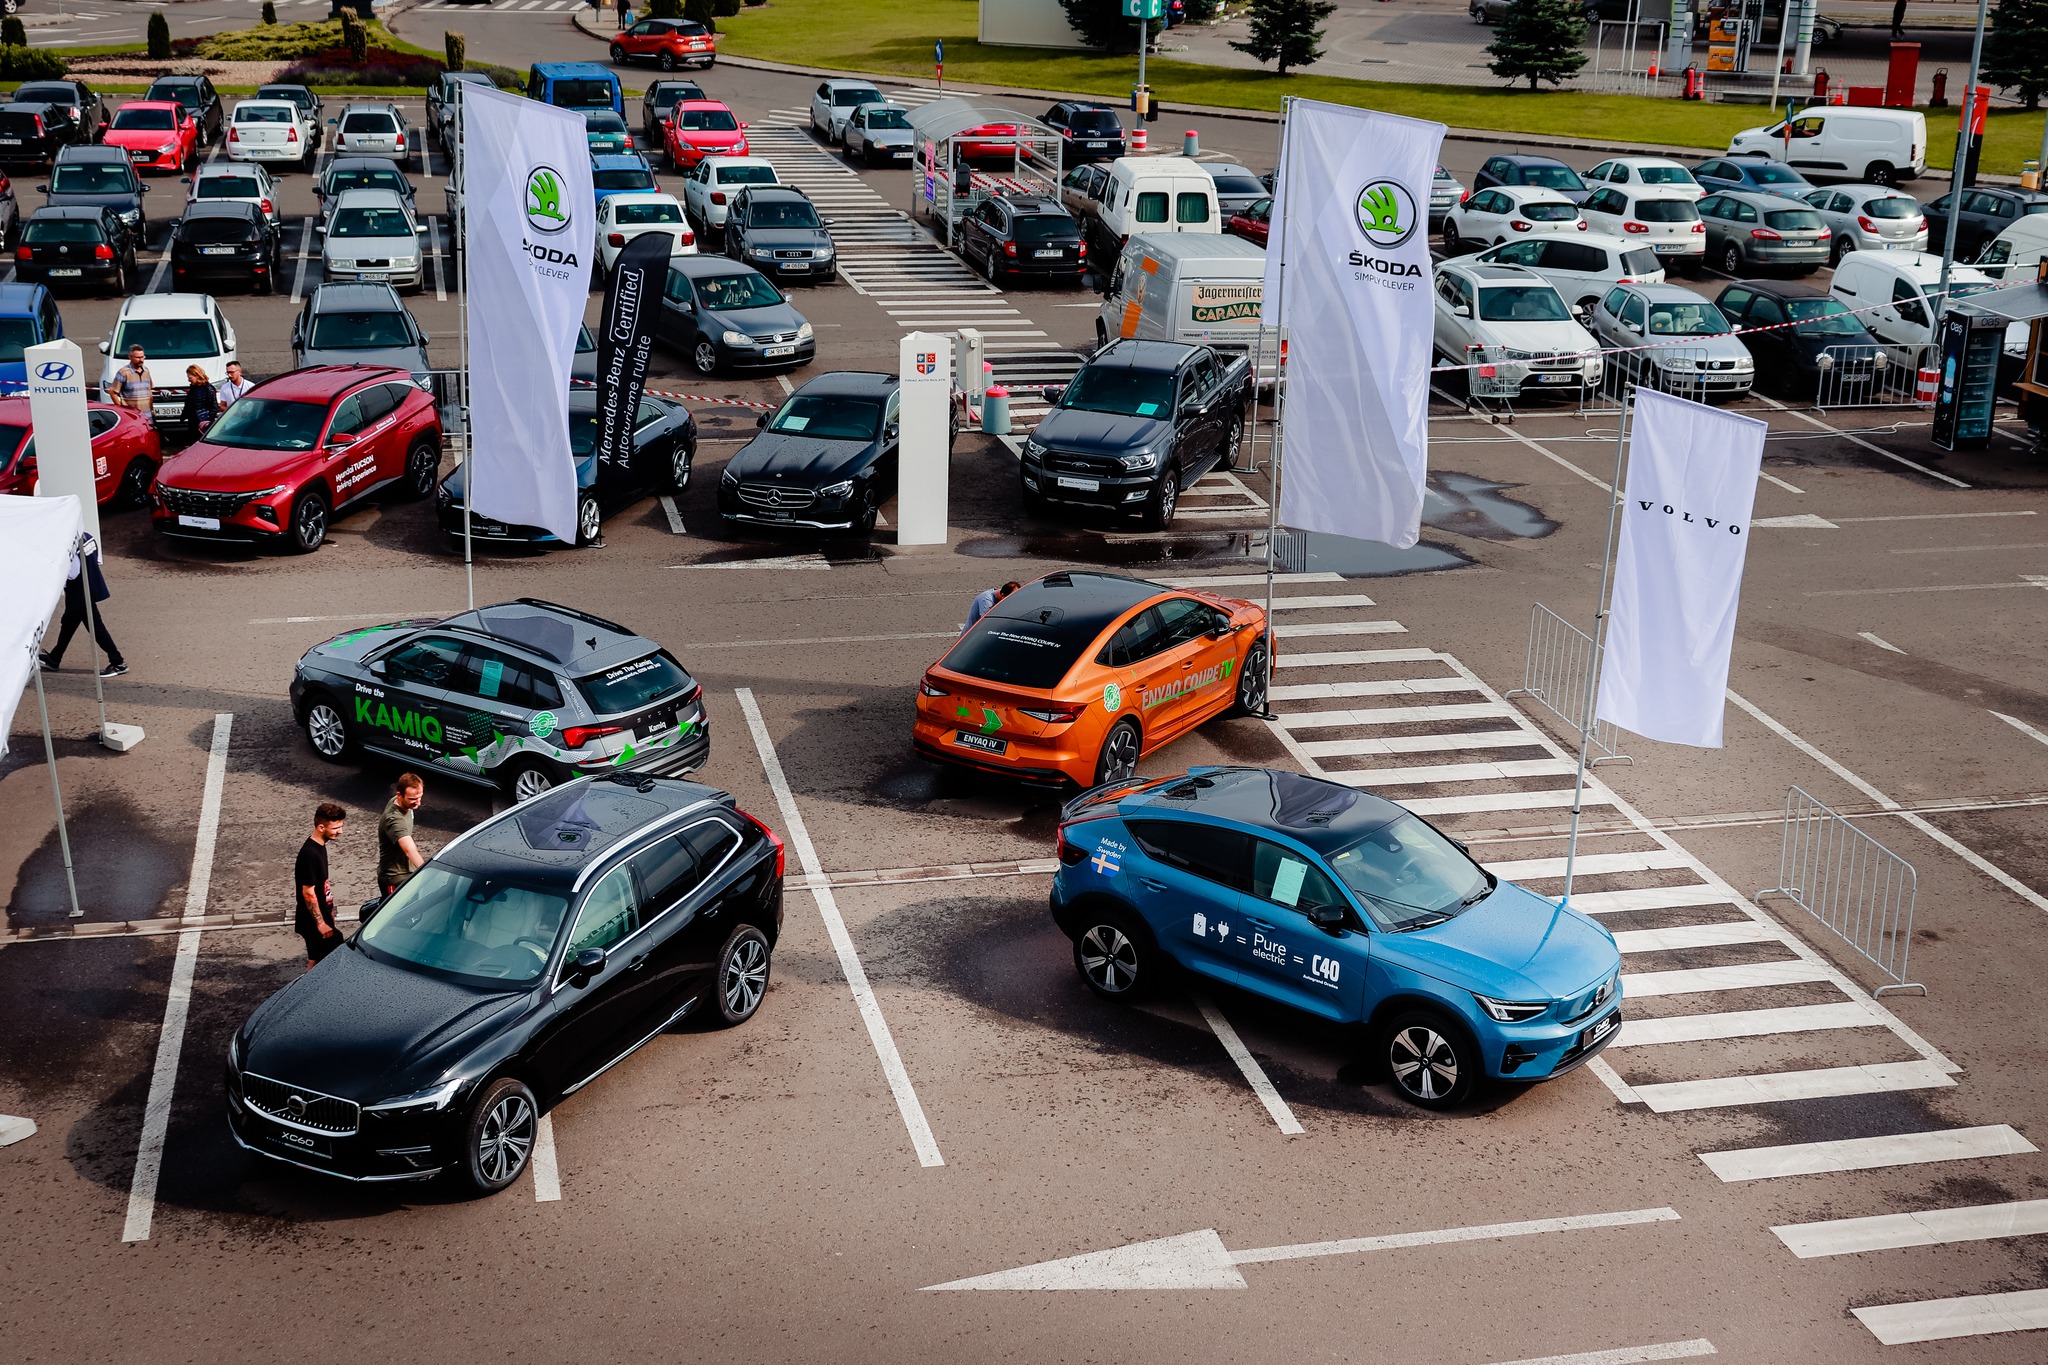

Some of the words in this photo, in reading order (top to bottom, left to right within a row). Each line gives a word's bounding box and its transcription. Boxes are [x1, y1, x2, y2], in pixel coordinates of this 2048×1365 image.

[1130, 0, 1141, 16] C
[1152, 0, 1158, 16] C
[538, 266, 570, 280] CLEVER
[1348, 250, 1422, 277] ŠKODA
[1354, 272, 1380, 284] SIMPLY
[1382, 280, 1414, 291] CLEVER
[614, 270, 640, 340] Certified
[600, 347, 626, 466] Mercedes-Benz
[617, 382, 639, 468] Autoturisme
[633, 335, 651, 379] rulate
[336, 465, 354, 482] Hyundai
[354, 454, 374, 471] TUCSON
[336, 479, 352, 493] Driving
[352, 465, 377, 484] Experience
[1638, 500, 1740, 535] VOLVO
[606, 670, 623, 679] Drive
[633, 660, 654, 669] Kamiq
[356, 683, 372, 695] Drive
[374, 688, 385, 698] the
[1142, 680, 1182, 711] ENYAQ
[1184, 664, 1220, 693] COUPE
[1219, 658, 1235, 680] iV
[569, 690, 586, 719] PORSCHE
[355, 696, 443, 744] KAMIQ
[648, 722, 666, 733] Kamiq
[964, 735, 988, 748] ENYAQ
[1096, 846, 1121, 859] Sweden
[1101, 837, 1118, 848] Made
[1118, 842, 1126, 852] by
[1253, 932, 1286, 955] Pure
[1253, 948, 1286, 966] electric
[1312, 954, 1340, 982] C40
[282, 1132, 314, 1146] XC60
